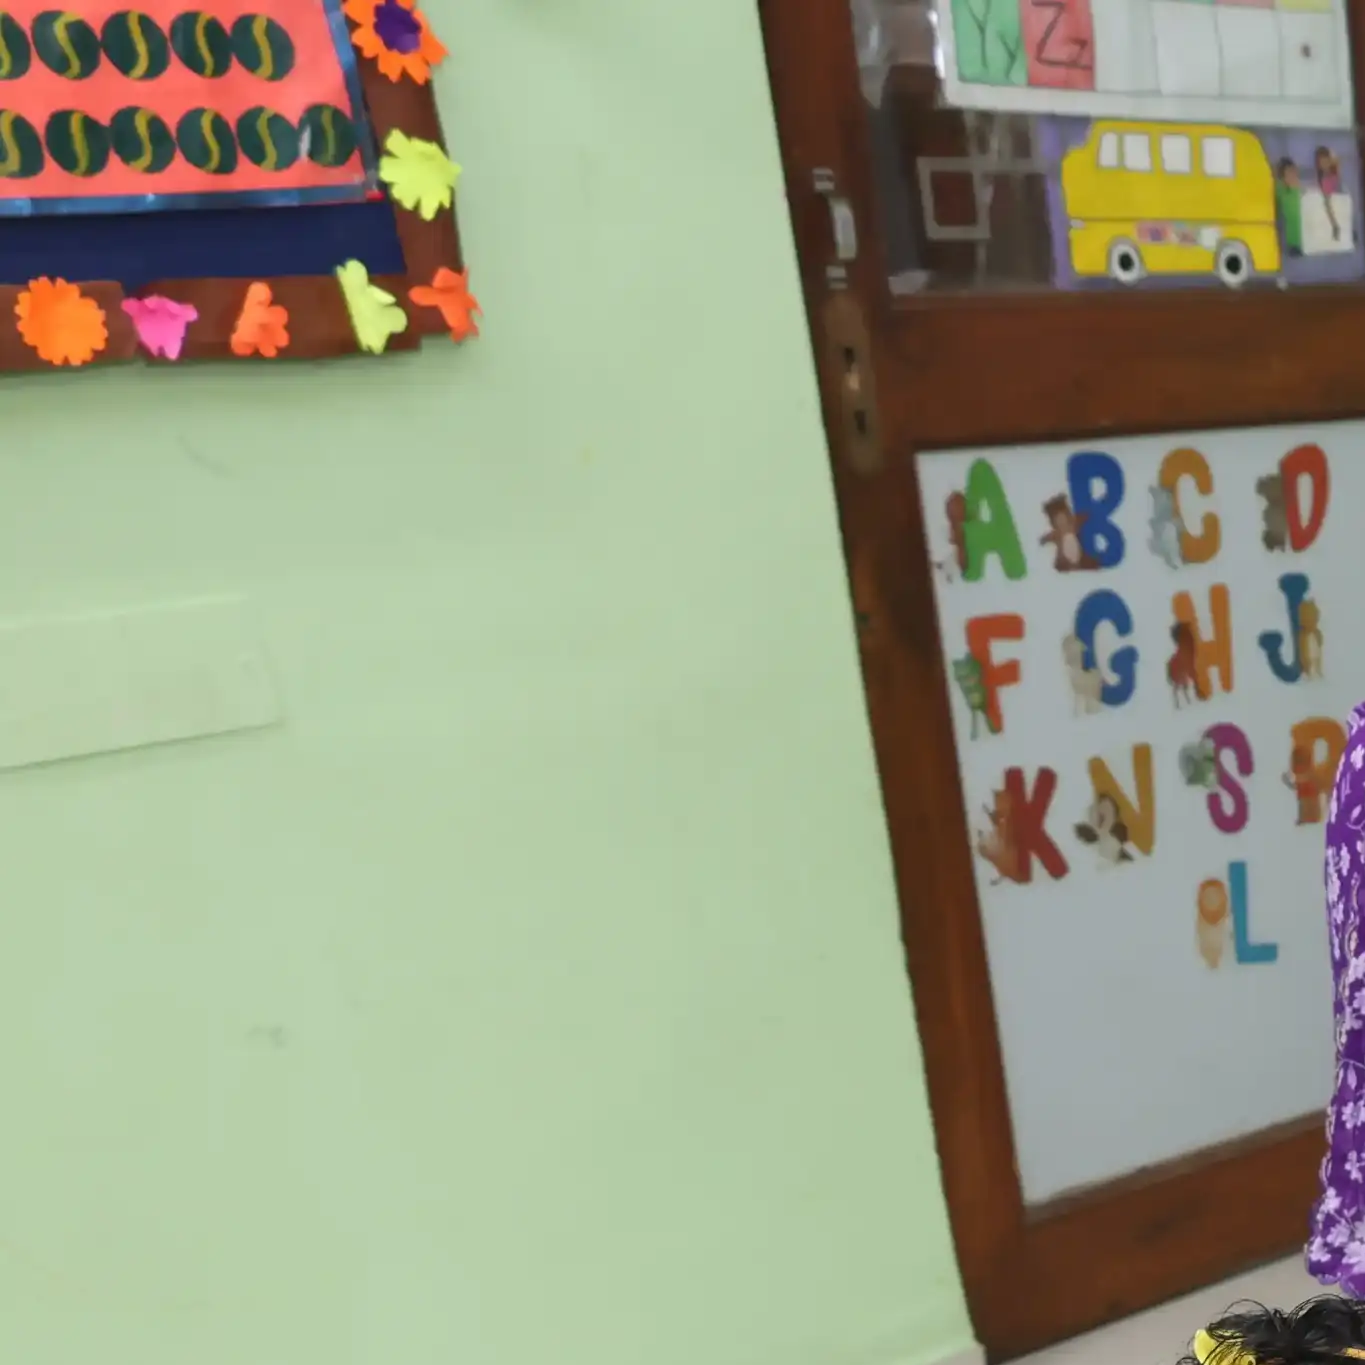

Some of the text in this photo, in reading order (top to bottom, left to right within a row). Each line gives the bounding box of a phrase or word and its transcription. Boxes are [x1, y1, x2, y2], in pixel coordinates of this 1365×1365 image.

[963, 443, 1329, 581] A B C D
[966, 573, 1309, 735] F G H J
[1005, 767, 1069, 883] K
[1088, 743, 1156, 856] N
[1202, 722, 1253, 834] S
[1229, 861, 1278, 964] L
